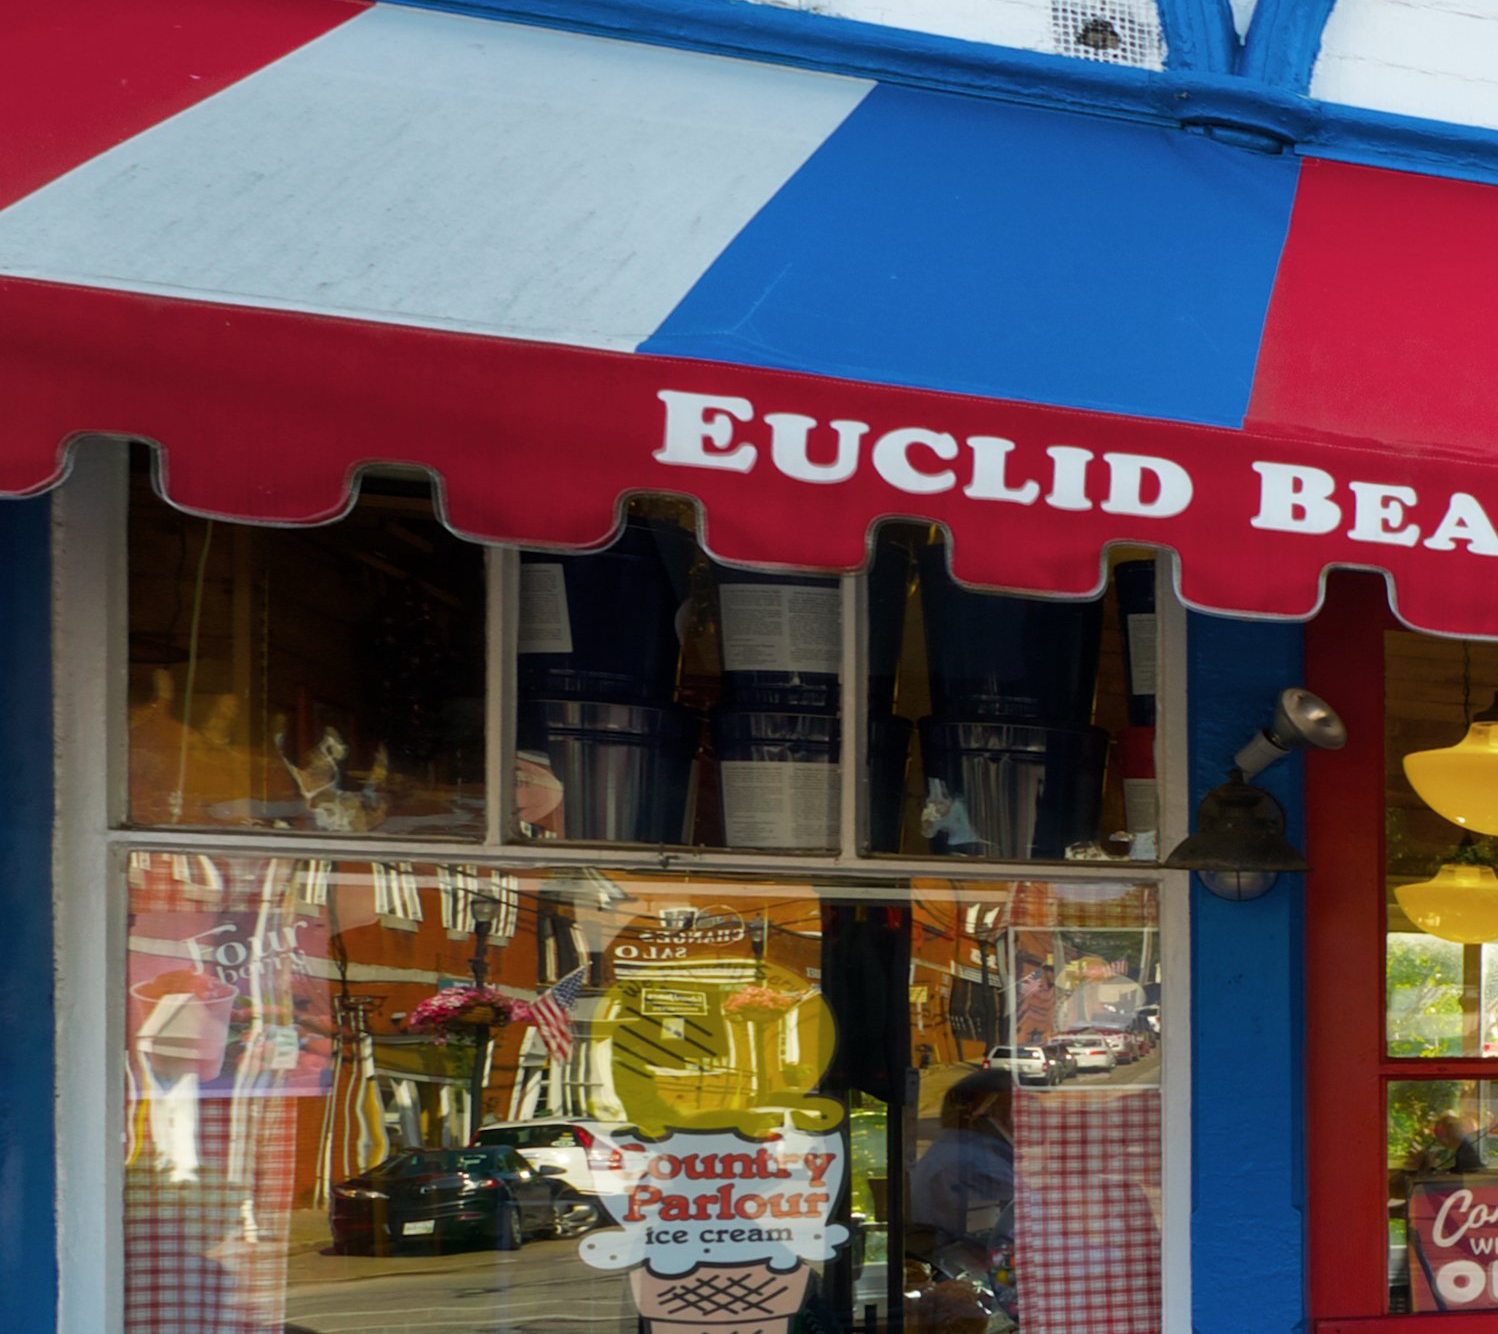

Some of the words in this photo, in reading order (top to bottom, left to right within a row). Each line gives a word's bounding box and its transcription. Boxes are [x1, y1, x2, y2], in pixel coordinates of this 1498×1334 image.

[652, 389, 1194, 519] EUCLID
[622, 1183, 830, 1222] Parlour
[645, 1227, 689, 1245] ice
[699, 1227, 793, 1245] cream
